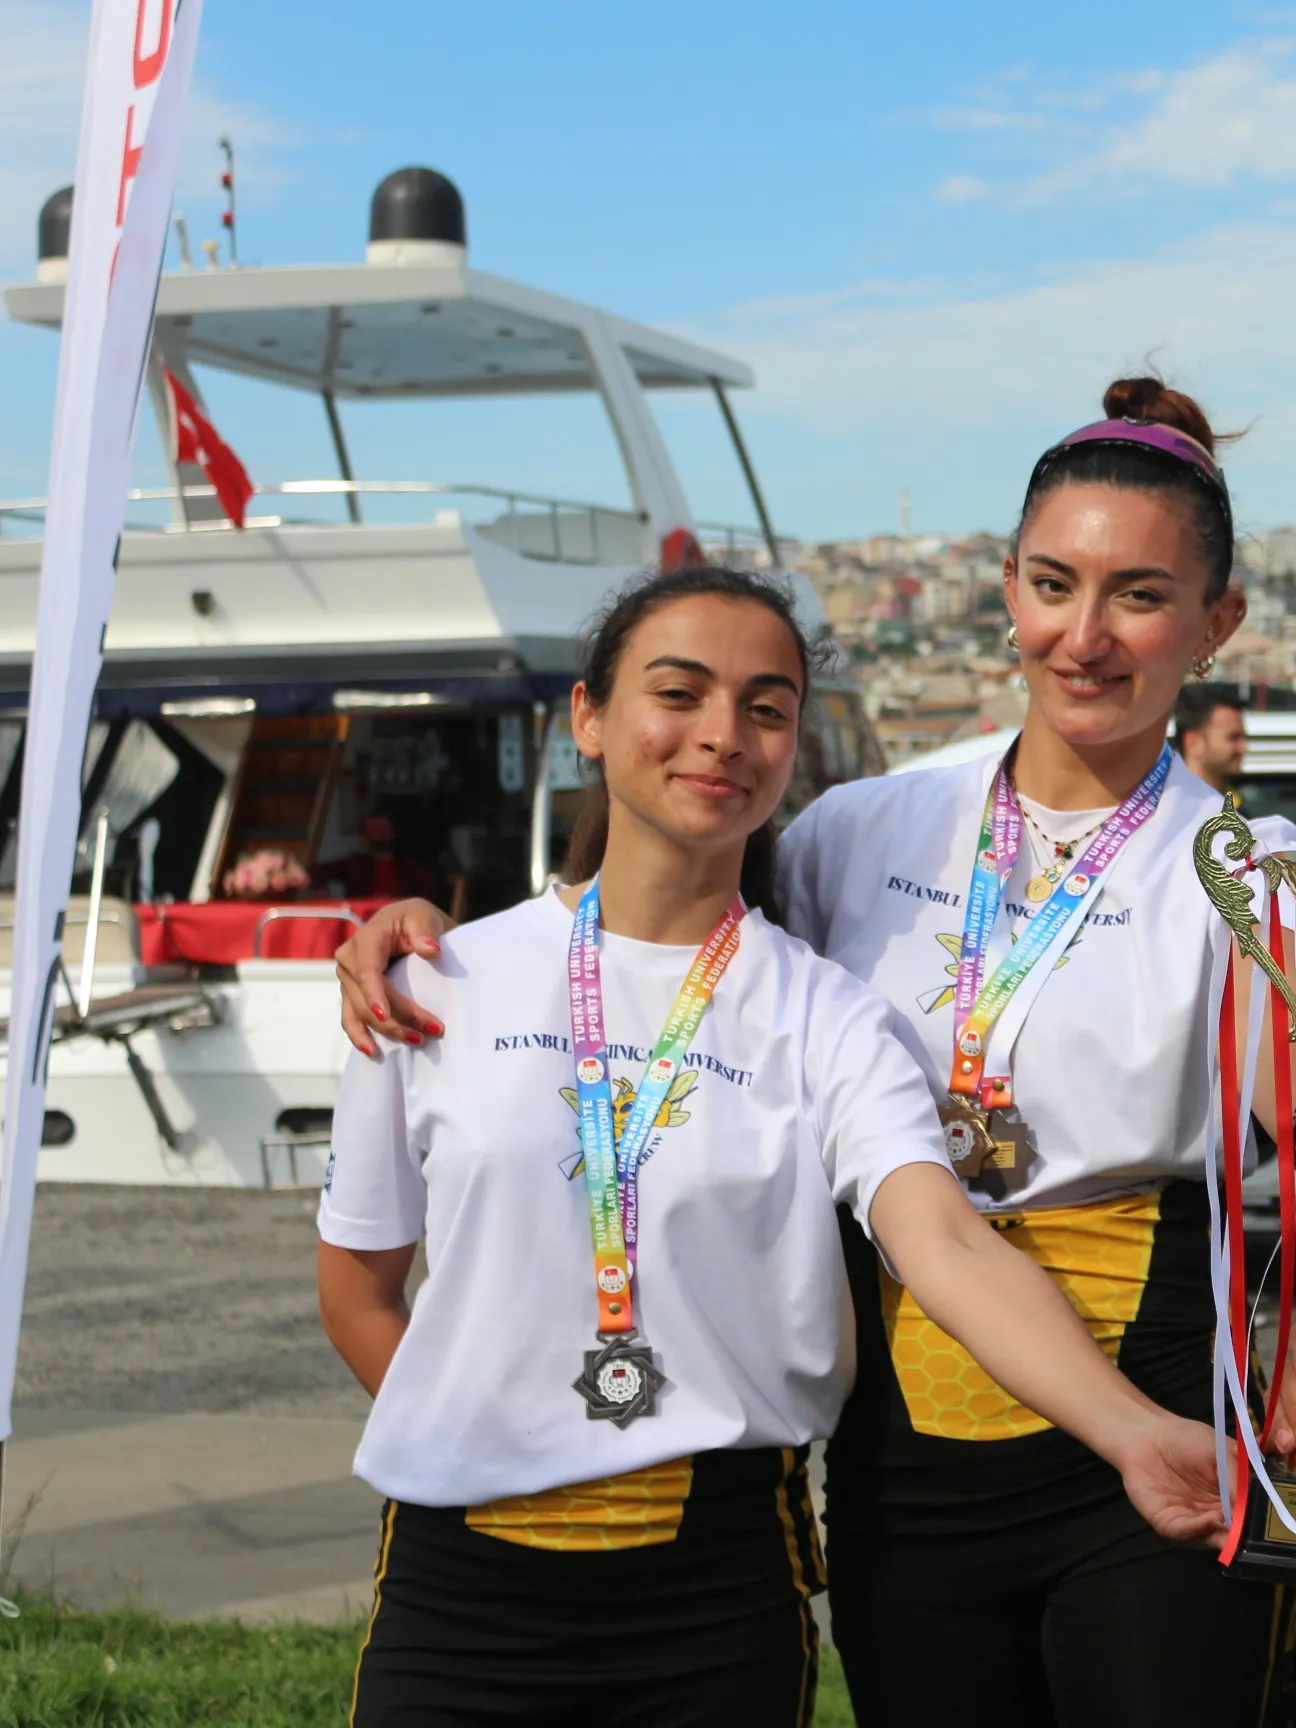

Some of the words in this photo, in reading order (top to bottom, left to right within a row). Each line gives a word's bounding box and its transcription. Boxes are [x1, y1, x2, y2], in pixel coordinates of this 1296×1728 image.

[995, 806, 1007, 860] TURKISH
[1008, 815, 1020, 855] SPORTS
[1084, 816, 1124, 862] TURKISH
[1120, 760, 1167, 817] UNIVERSITY
[1095, 828, 1130, 868] SPORTS
[1129, 785, 1163, 826] FEDERA
[887, 876, 963, 908] ISTANBUL
[570, 908, 585, 978] UNIVERSITY
[584, 900, 596, 979] FEDERATION
[1020, 907, 1070, 973] FEDERASYONU
[662, 985, 696, 1043] TURKISH
[690, 914, 736, 983] UNIVERSITY
[676, 997, 706, 1047] SPORTS
[702, 924, 741, 990] FEDERATIO
[495, 1034, 572, 1053] ISTANBUL
[571, 982, 585, 1044] TURKISH
[587, 988, 600, 1042] SPORTS
[597, 1098, 614, 1188] FEDERASYONU
[627, 1096, 661, 1180] FEDERASYONU
[606, 1187, 622, 1248] SPORLARI
[626, 1183, 636, 1243] SPORLARI
